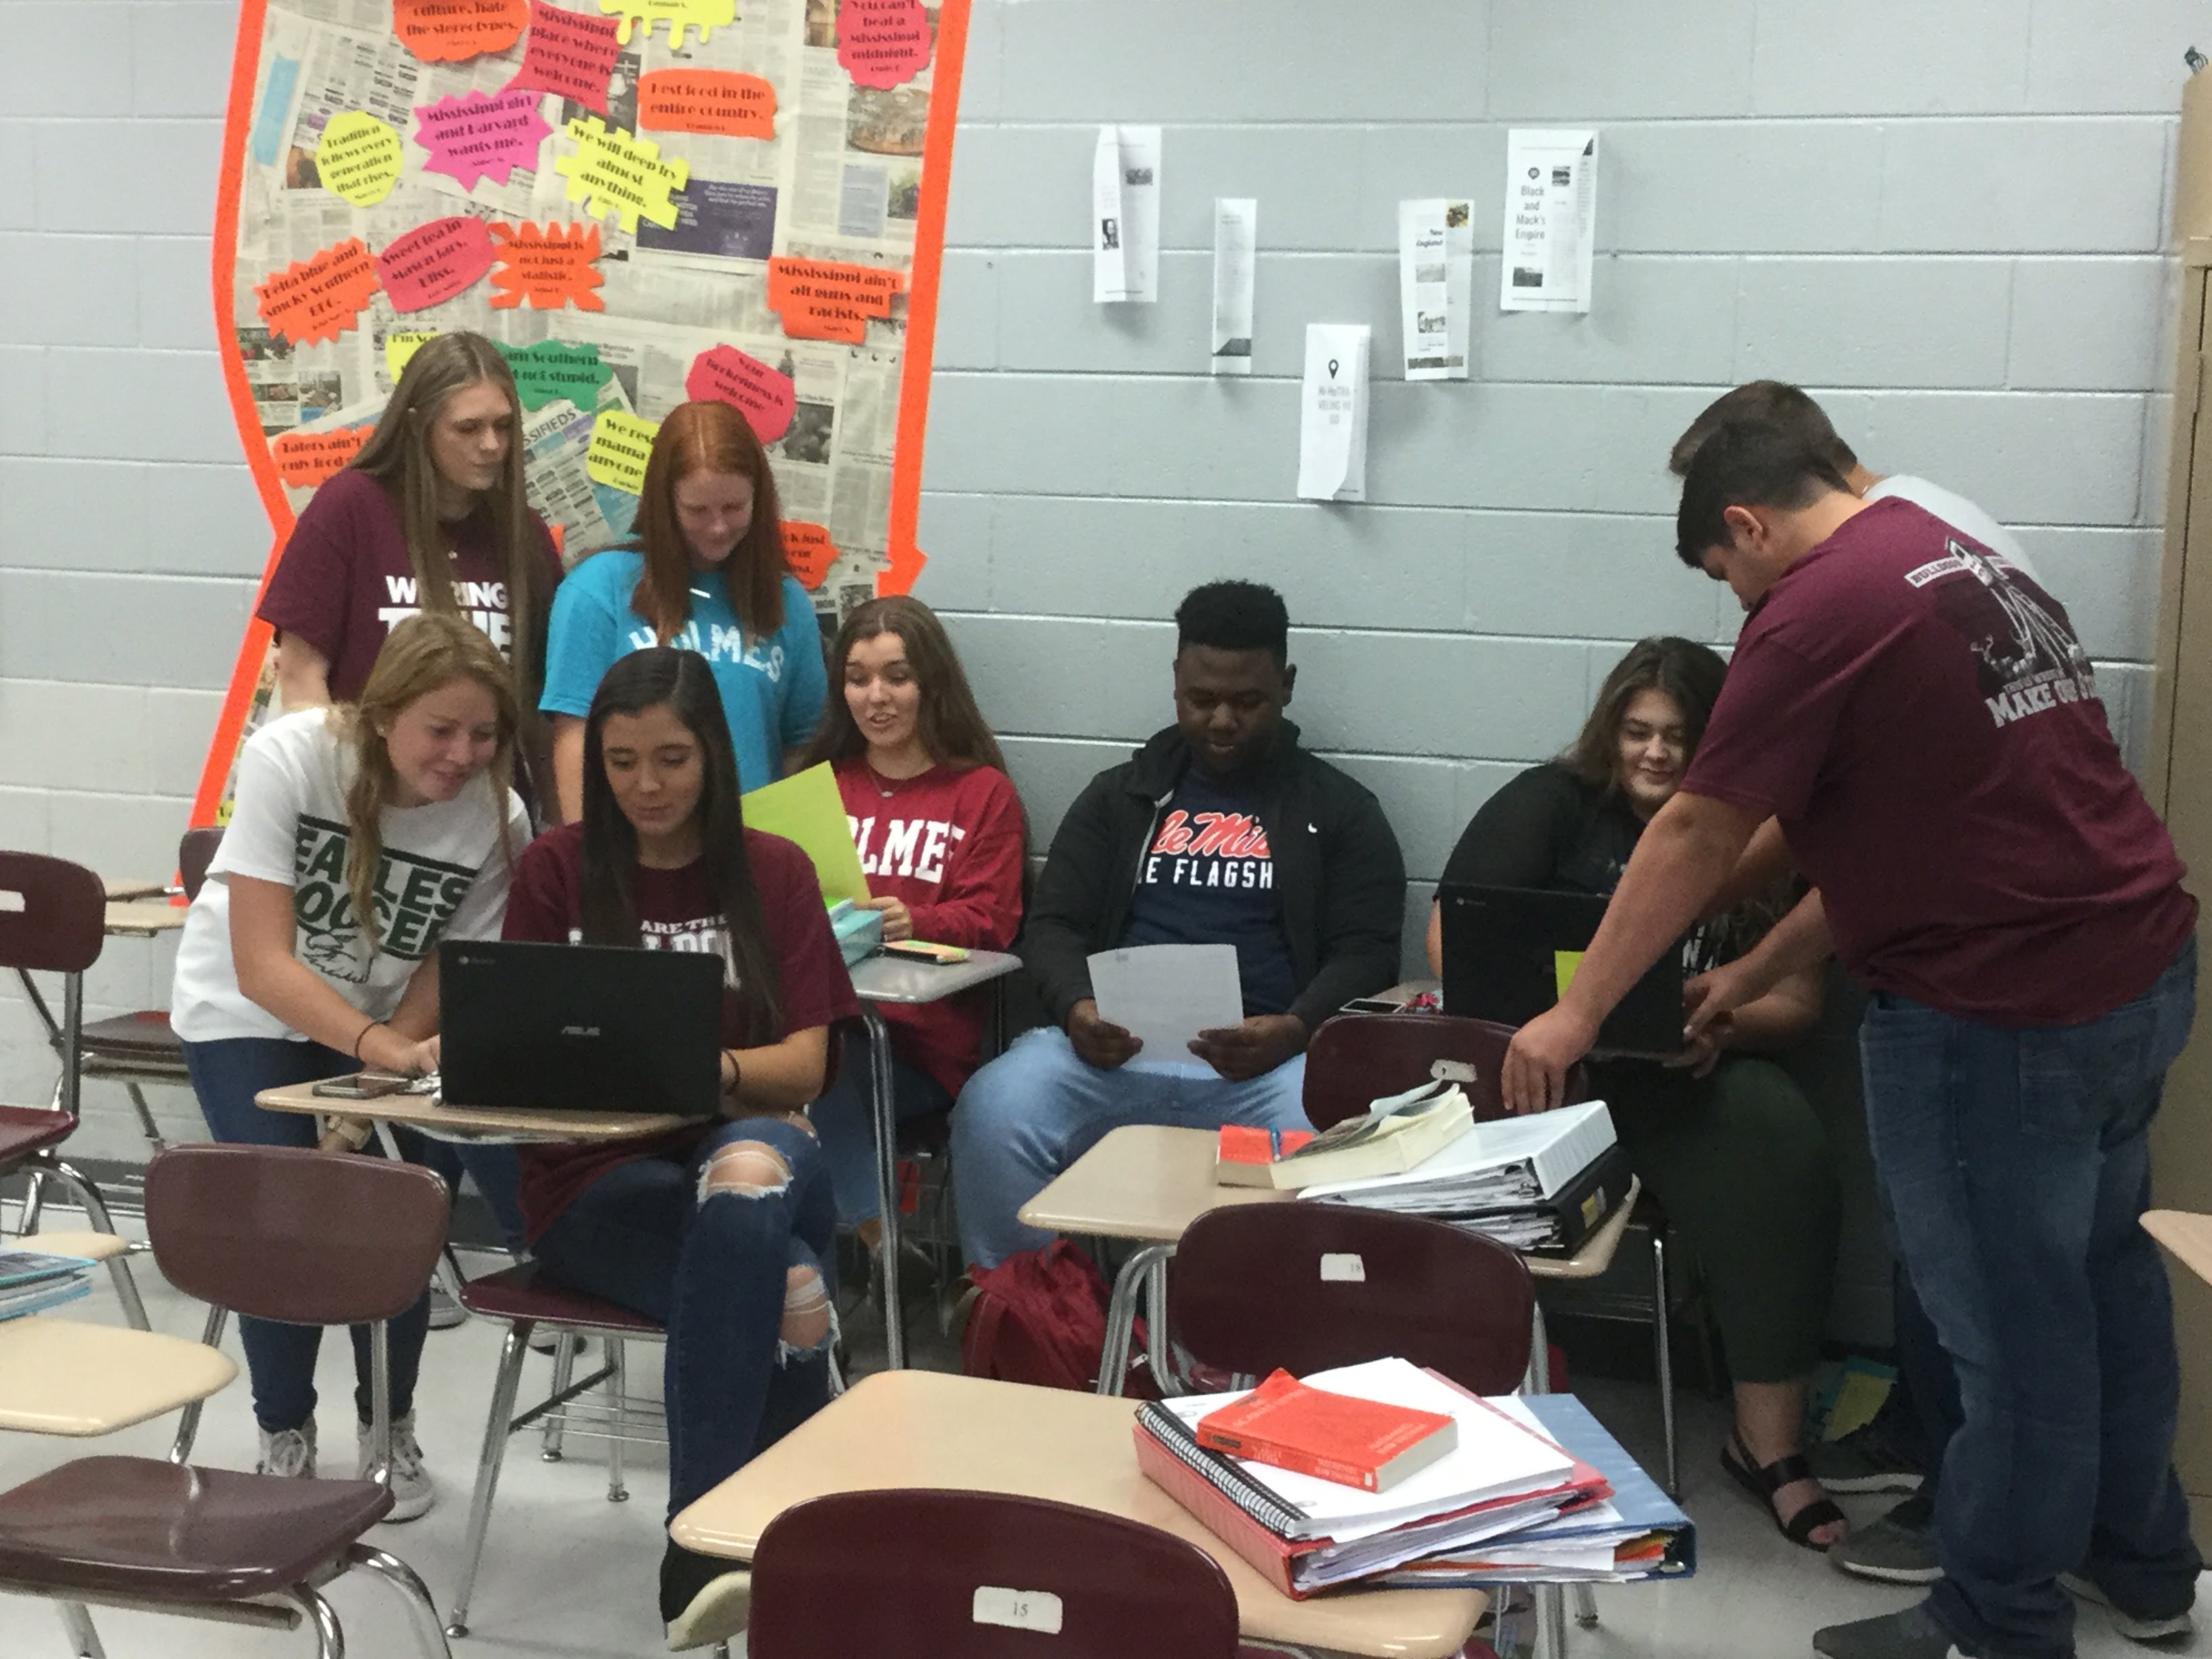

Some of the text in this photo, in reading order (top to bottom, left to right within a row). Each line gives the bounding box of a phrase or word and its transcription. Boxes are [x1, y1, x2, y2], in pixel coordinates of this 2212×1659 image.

[407, 24, 430, 36] the
[896, 17, 905, 26] a
[851, 30, 920, 43] Mississippi
[531, 47, 596, 71] everyone
[722, 85, 739, 99] in
[741, 88, 766, 101] the
[428, 100, 504, 121] Mississippi
[649, 103, 697, 115] entire
[327, 125, 380, 148] Tradition
[435, 125, 465, 141] and
[321, 138, 391, 166] follows every
[447, 141, 491, 157] wants
[574, 125, 678, 181] We will deep fry
[330, 154, 392, 180] generation
[596, 159, 644, 186] almost
[381, 220, 462, 266] Sweet tea in
[519, 255, 538, 266] not
[778, 264, 861, 283] Mississippi
[790, 285, 884, 306] all guns and
[606, 418, 627, 434] We
[588, 455, 644, 477] anyone
[1173, 858, 1274, 888] FLAGSH
[640, 920, 683, 935] ARE
[1013, 1601, 1029, 1617] 15
